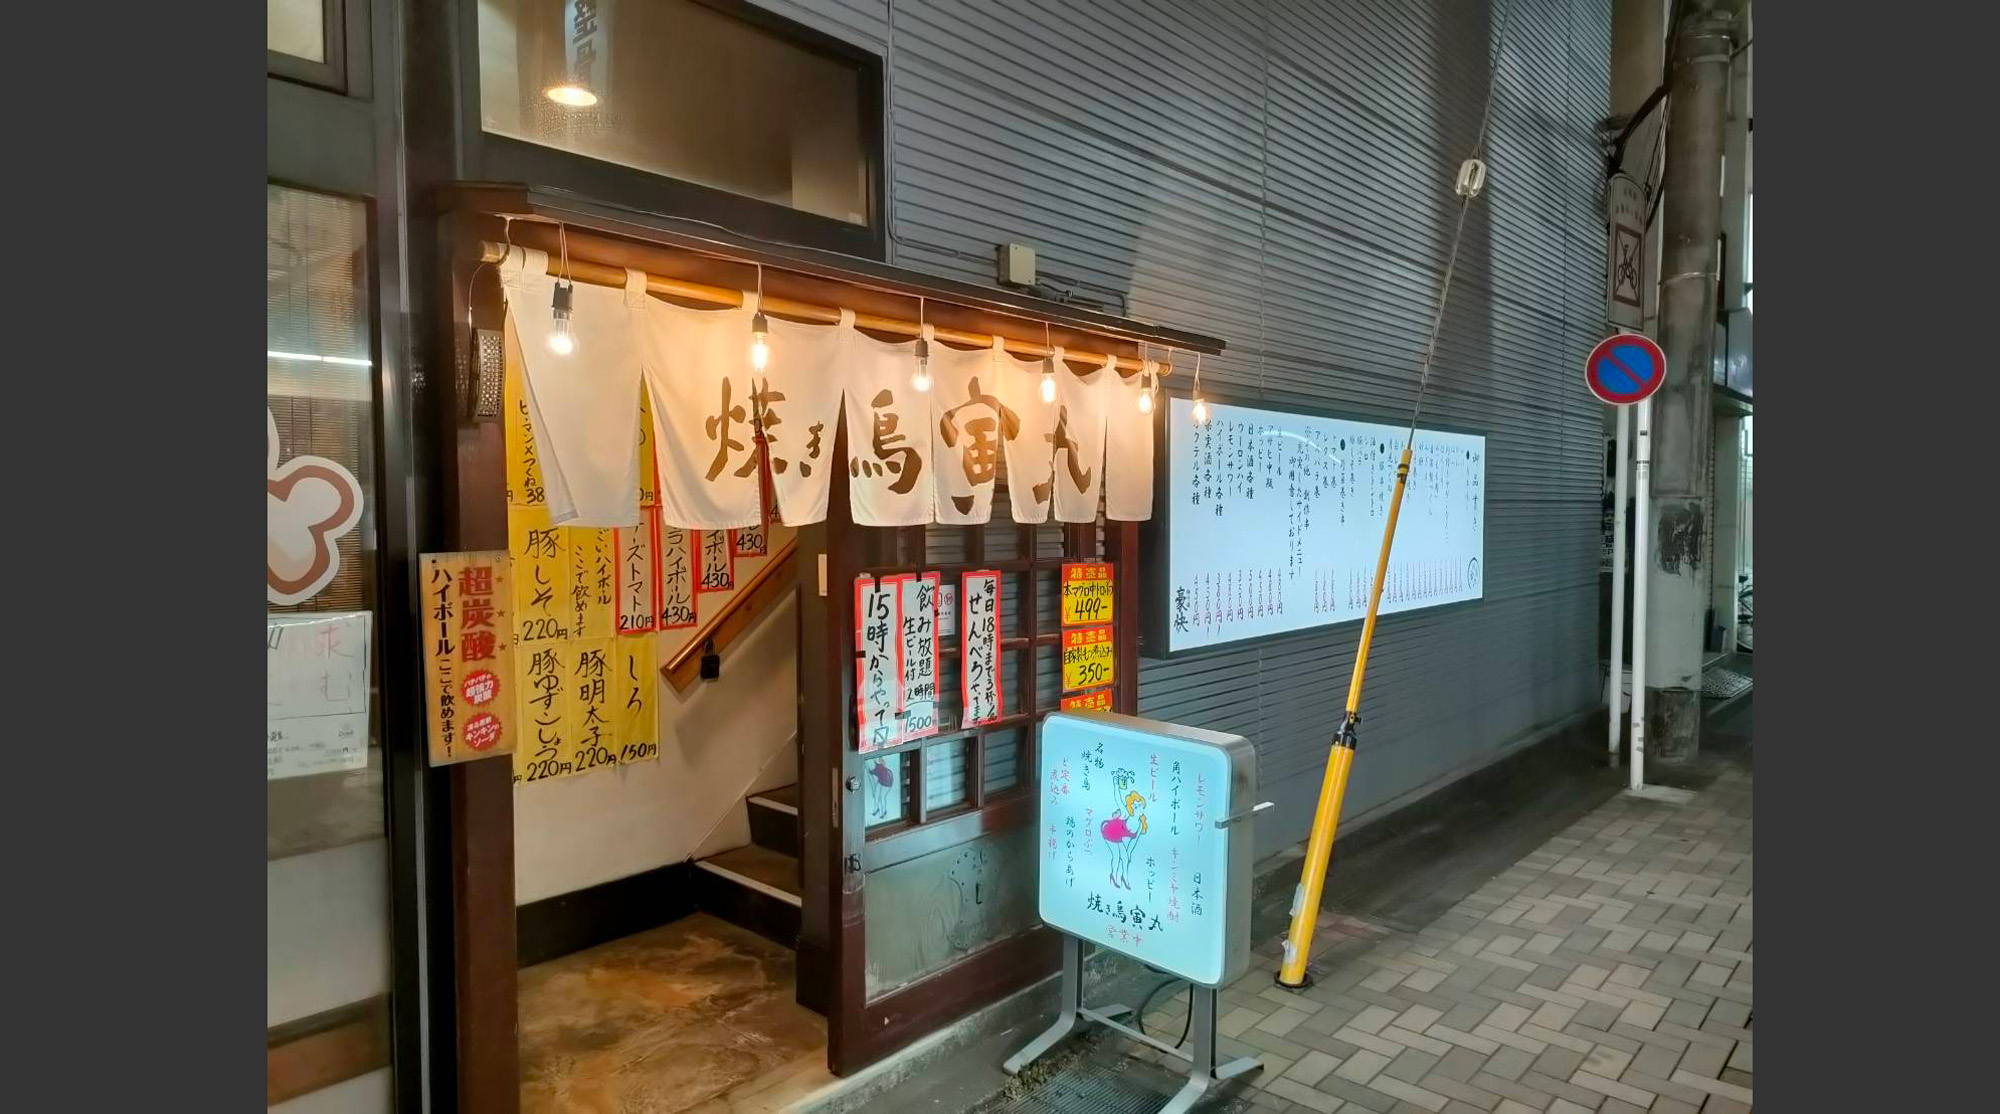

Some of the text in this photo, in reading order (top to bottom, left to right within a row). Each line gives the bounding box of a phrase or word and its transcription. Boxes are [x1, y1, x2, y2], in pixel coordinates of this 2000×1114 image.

[705, 376, 1091, 515] 焼き鳥寅丸
[524, 528, 566, 617] 豚しそ
[572, 546, 591, 638] ここで飲めます
[666, 530, 690, 606] ラハイボール
[458, 566, 497, 662] 超炭酸
[523, 618, 568, 641] 220円
[620, 615, 654, 630] 210円
[661, 606, 697, 625] 430円
[916, 585, 935, 679] 飲み放題
[527, 648, 566, 762] 豚ゆずこしょう
[574, 649, 613, 748] 豚明太子
[627, 654, 643, 718] しろ
[526, 760, 572, 782] 220円
[575, 746, 617, 772] 220円
[619, 742, 657, 761] 150円
[1149, 753, 1159, 803] 生ビール
[1170, 761, 1182, 836] 角ハイボール
[1086, 891, 1164, 932] 焼き鳥寅丸
[1191, 871, 1204, 916] 日本酒
